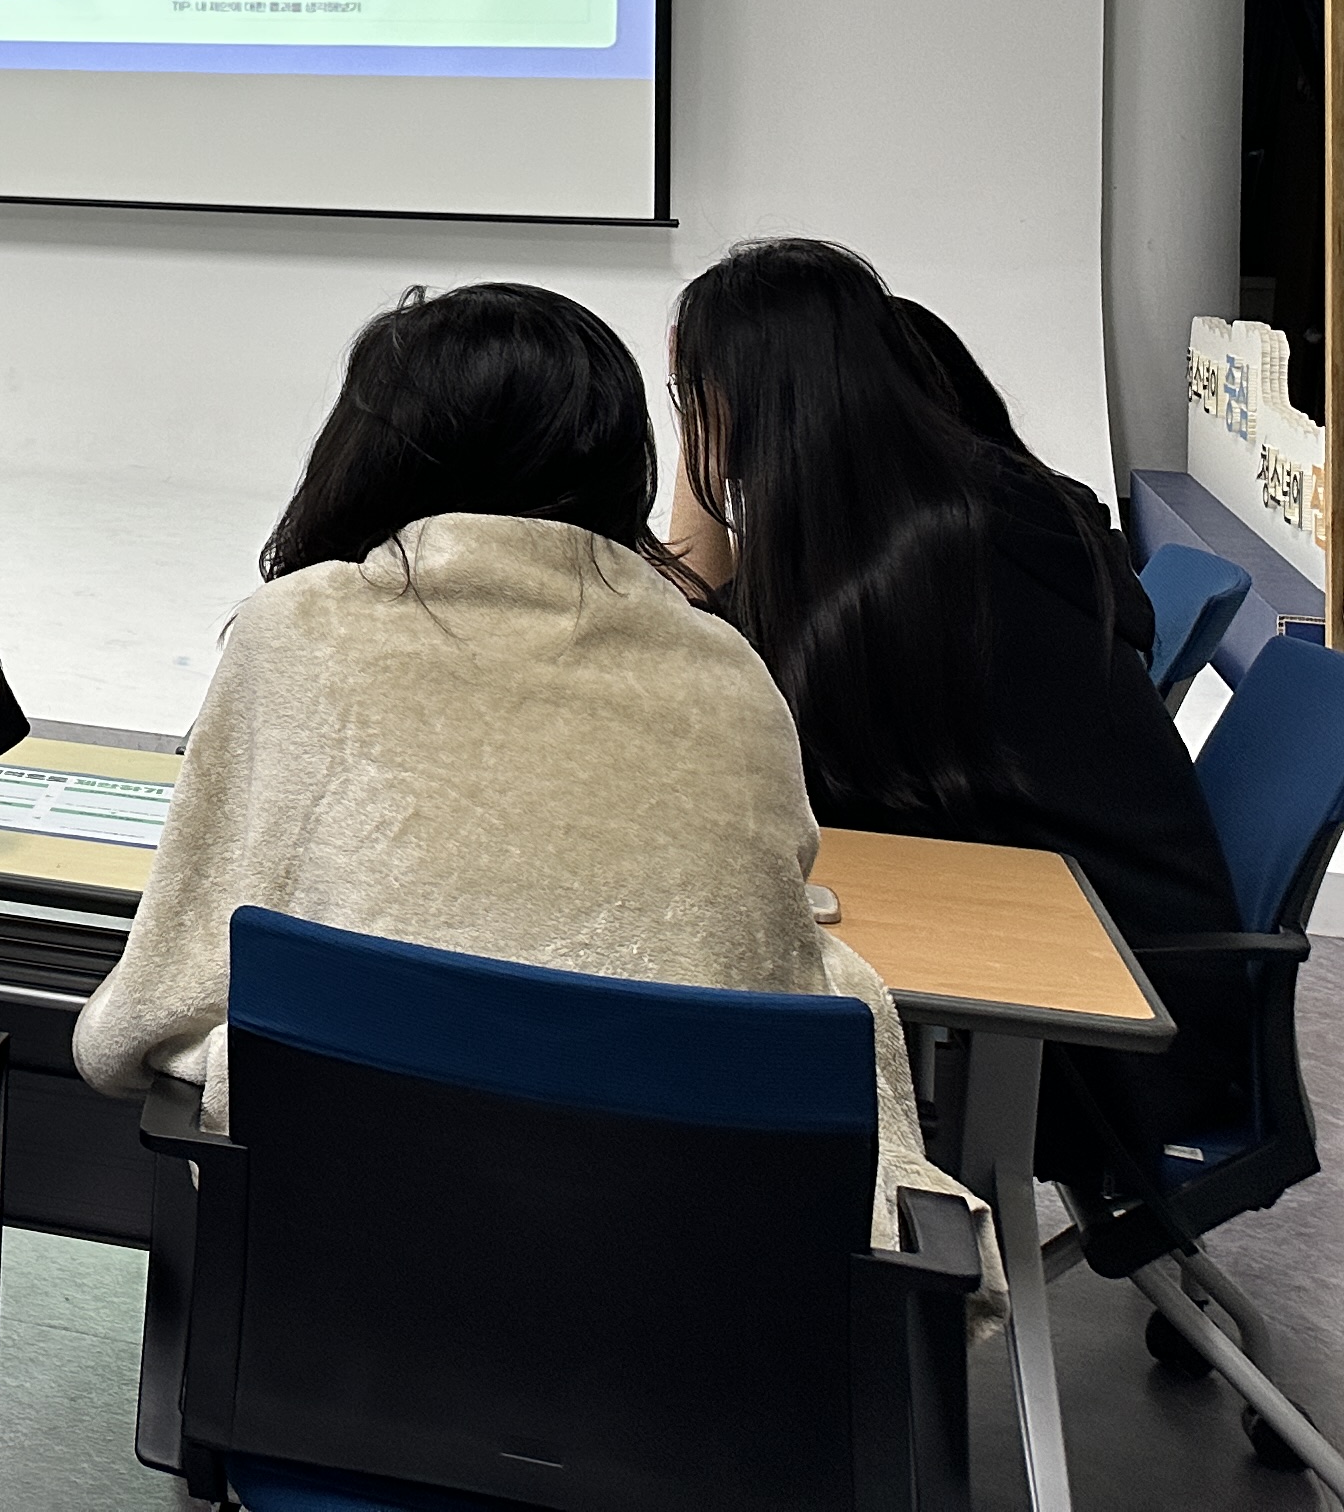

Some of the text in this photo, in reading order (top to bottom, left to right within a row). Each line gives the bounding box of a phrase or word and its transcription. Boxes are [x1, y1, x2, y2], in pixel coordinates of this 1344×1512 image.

[195, 1, 207, 12] 내
[209, 1, 242, 12] 제안에
[244, 1, 266, 12] 대한
[1224, 354, 1250, 441] 중심
